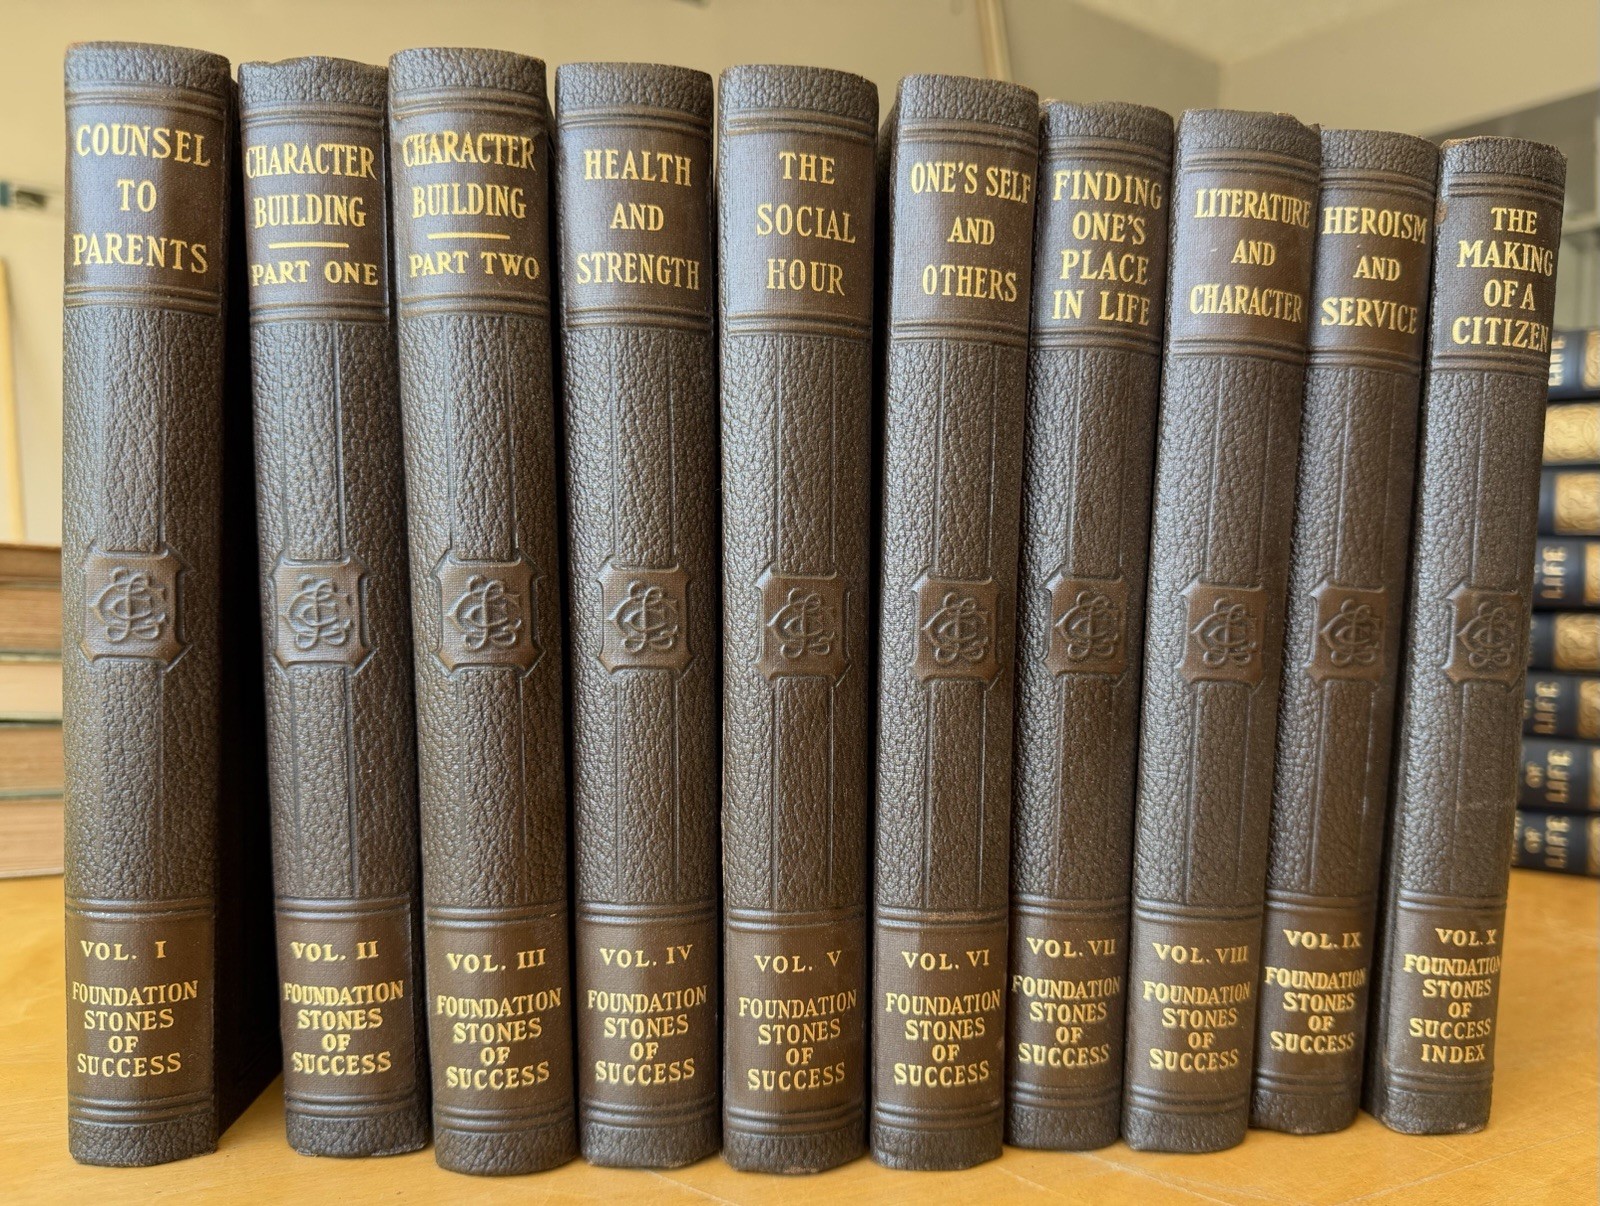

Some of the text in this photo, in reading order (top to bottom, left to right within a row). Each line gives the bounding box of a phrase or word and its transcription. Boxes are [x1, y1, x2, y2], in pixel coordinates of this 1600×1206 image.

[76, 123, 210, 166] COUNSEL
[403, 130, 535, 170] CHARACTER
[246, 143, 376, 179] CHARACTER
[585, 149, 691, 186] HEALTH
[779, 151, 834, 184] THE
[911, 161, 1030, 203] ONE'S SELF
[1053, 170, 1161, 209] FINDING
[117, 179, 156, 212] TO
[412, 183, 526, 219] BUILDING
[1194, 188, 1312, 229] LITERATURE
[254, 193, 366, 228] BUILDING
[610, 203, 663, 231] AND
[757, 203, 855, 243] SOCIAL
[1491, 207, 1537, 234] THE
[947, 216, 994, 245] AND
[1072, 211, 1145, 245] ONE'S
[1322, 207, 1427, 243] HEROISM
[73, 233, 208, 273] PARENTS
[410, 250, 539, 279] PART TWO
[1231, 240, 1275, 266] AND
[1456, 240, 1552, 276] MAKING
[252, 260, 378, 285] PART ONE
[576, 252, 699, 289] STRENGTH
[767, 258, 845, 295] HOUR
[1060, 249, 1148, 284] PLACE
[1353, 256, 1400, 281] AND
[923, 264, 1017, 302] OTHERS
[1483, 279, 1536, 311] OF A
[1052, 290, 1149, 325] IN LIFE
[1190, 284, 1301, 322] CHARACTER
[1321, 297, 1416, 334] SERVICE
[1451, 316, 1549, 353] CITIZEN
[1541, 546, 1567, 599] LIFE
[1533, 681, 1560, 734] LIFE
[1546, 750, 1573, 803] LIFE
[1026, 937, 1114, 958] VOL. VII
[1283, 930, 1360, 949] VOL. IX
[1435, 927, 1496, 946] VOL. X
[81, 941, 166, 960] VOL. I
[291, 941, 378, 962] VOL. II
[447, 949, 545, 973] VOL. III
[600, 944, 692, 968] VOL. IV
[754, 950, 841, 974] VOL. V
[902, 949, 989, 971] VOL. VI
[1152, 942, 1247, 964] VOL. VIII
[1012, 975, 1119, 1000] FOUNDATION
[1265, 967, 1364, 990] FOUNDATION
[1422, 979, 1491, 998] STONES
[73, 980, 198, 1006] FOUNDATION
[284, 981, 403, 1006] FOUNDATION
[437, 988, 561, 1018] FOUNDATION
[588, 987, 706, 1014] FOUNDATION
[739, 991, 856, 1019] FOUNDATION
[886, 989, 1000, 1016] FOUNDATION
[1143, 981, 1249, 1005] FOUNDATION
[1283, 992, 1354, 1012] STONES
[85, 1009, 174, 1031] STONES
[298, 1008, 383, 1031] STONES
[1030, 1001, 1106, 1024] STONES
[1162, 1008, 1236, 1029] STONES
[1448, 1002, 1472, 1018] OF
[453, 1017, 542, 1044] STONES
[604, 1014, 688, 1039] STONES
[758, 1019, 840, 1045] STONES
[905, 1017, 985, 1041] STONES
[1056, 1027, 1083, 1044] OF
[1308, 1015, 1334, 1032] OF
[1409, 1018, 1490, 1039] SUCCESS
[108, 1036, 138, 1053] OF
[322, 1034, 350, 1052] OF
[630, 1042, 658, 1061] OF
[932, 1044, 959, 1062] OF
[1188, 1032, 1214, 1049] OF
[1271, 1031, 1353, 1054] SUCCESS
[1421, 1044, 1485, 1063] INDEX
[78, 1052, 181, 1078] SUCCESS
[292, 1051, 391, 1076] SUCCESS
[480, 1047, 510, 1066] OF
[786, 1048, 813, 1066] OF
[1018, 1043, 1108, 1068] SUCCESS
[1150, 1048, 1238, 1072] SUCCESS
[446, 1061, 549, 1090] SUCCESS
[596, 1054, 695, 1086] SUCCESS
[748, 1062, 844, 1091] SUCCESS
[894, 1061, 988, 1087] SUCCESS
